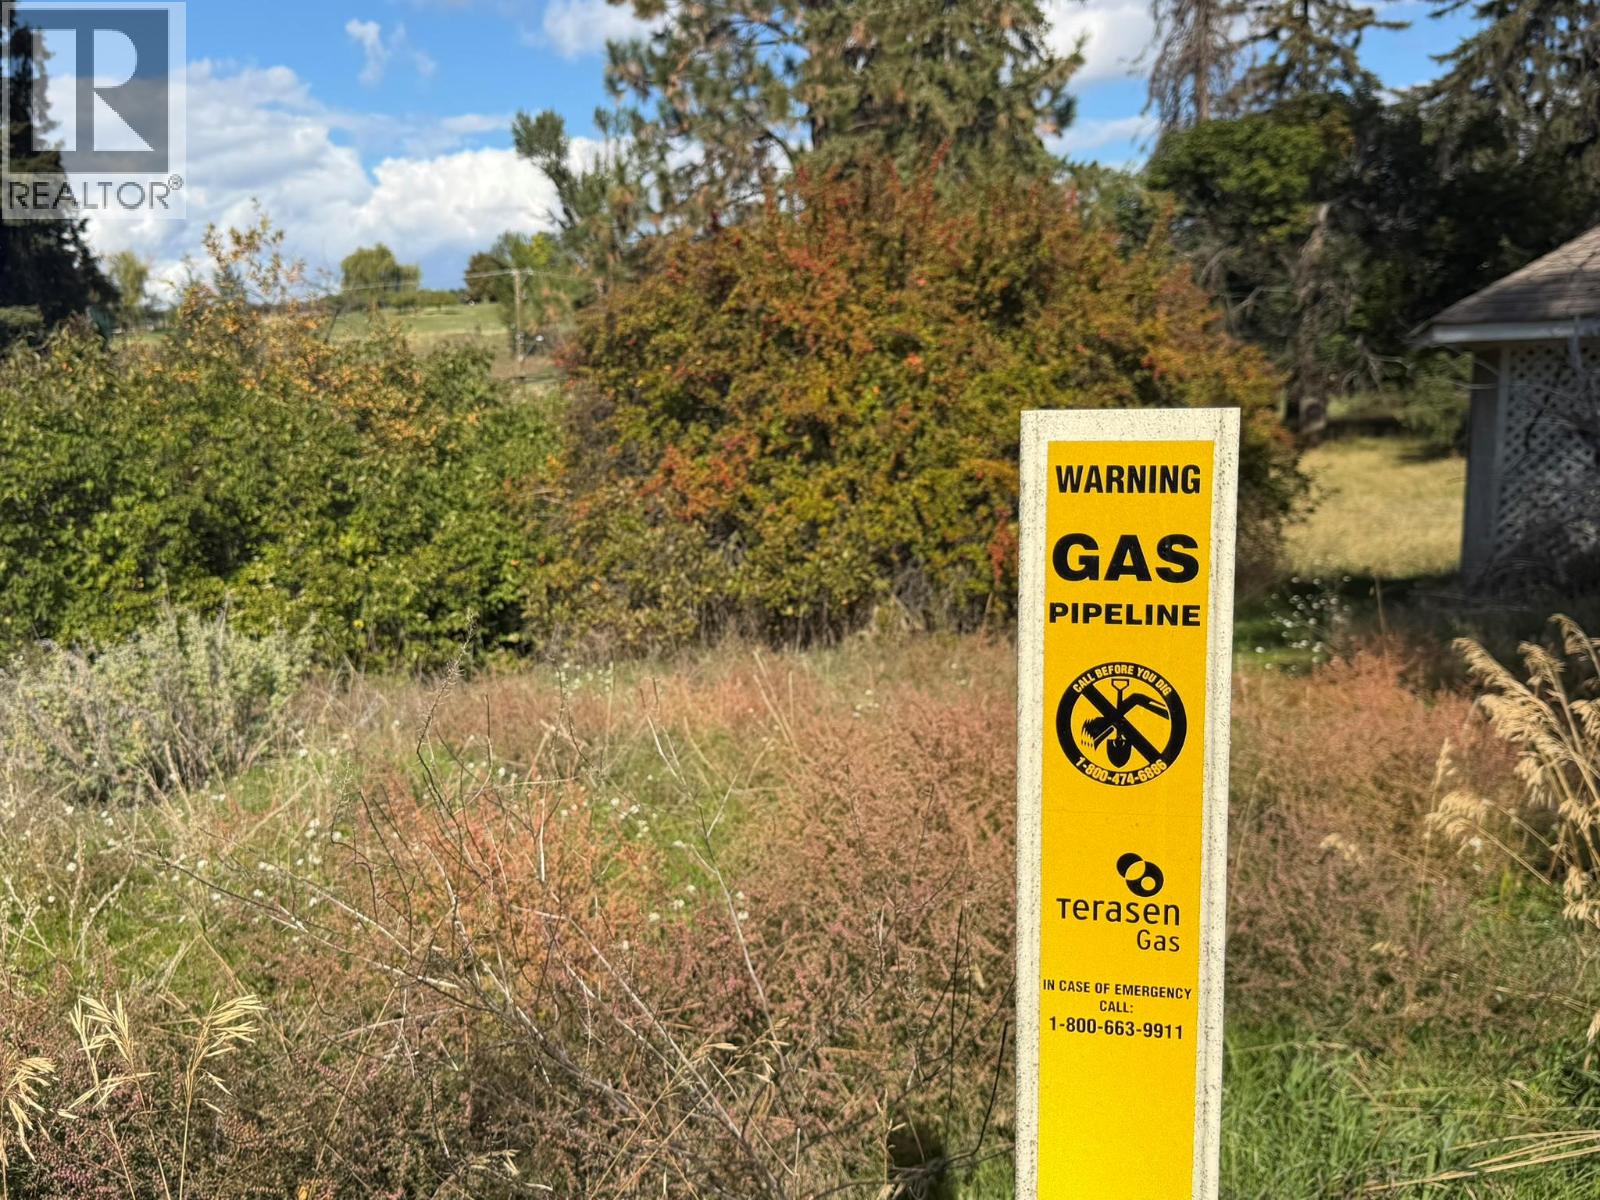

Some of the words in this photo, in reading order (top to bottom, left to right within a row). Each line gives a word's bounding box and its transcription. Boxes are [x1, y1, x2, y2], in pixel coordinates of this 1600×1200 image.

[1055, 464, 1201, 494] WARNING
[1052, 532, 1199, 584] GAS
[1049, 602, 1201, 627] PIPELINE
[1072, 673, 1096, 693] CALL
[1095, 664, 1135, 679] BEFORE
[1137, 667, 1158, 683] YOU
[1154, 681, 1173, 696] DIG
[1075, 756, 1168, 786] 1-800-474-6886
[1056, 897, 1180, 926] Terasen
[1136, 929, 1180, 952] Gas
[1043, 979, 1055, 991] IN
[1059, 979, 1090, 993] CASE
[1095, 982, 1110, 994] OF
[1114, 984, 1192, 1000] EMERGENCY
[1099, 1000, 1134, 1013] CALL:
[1049, 1016, 1183, 1040] 1-800-663-9911
